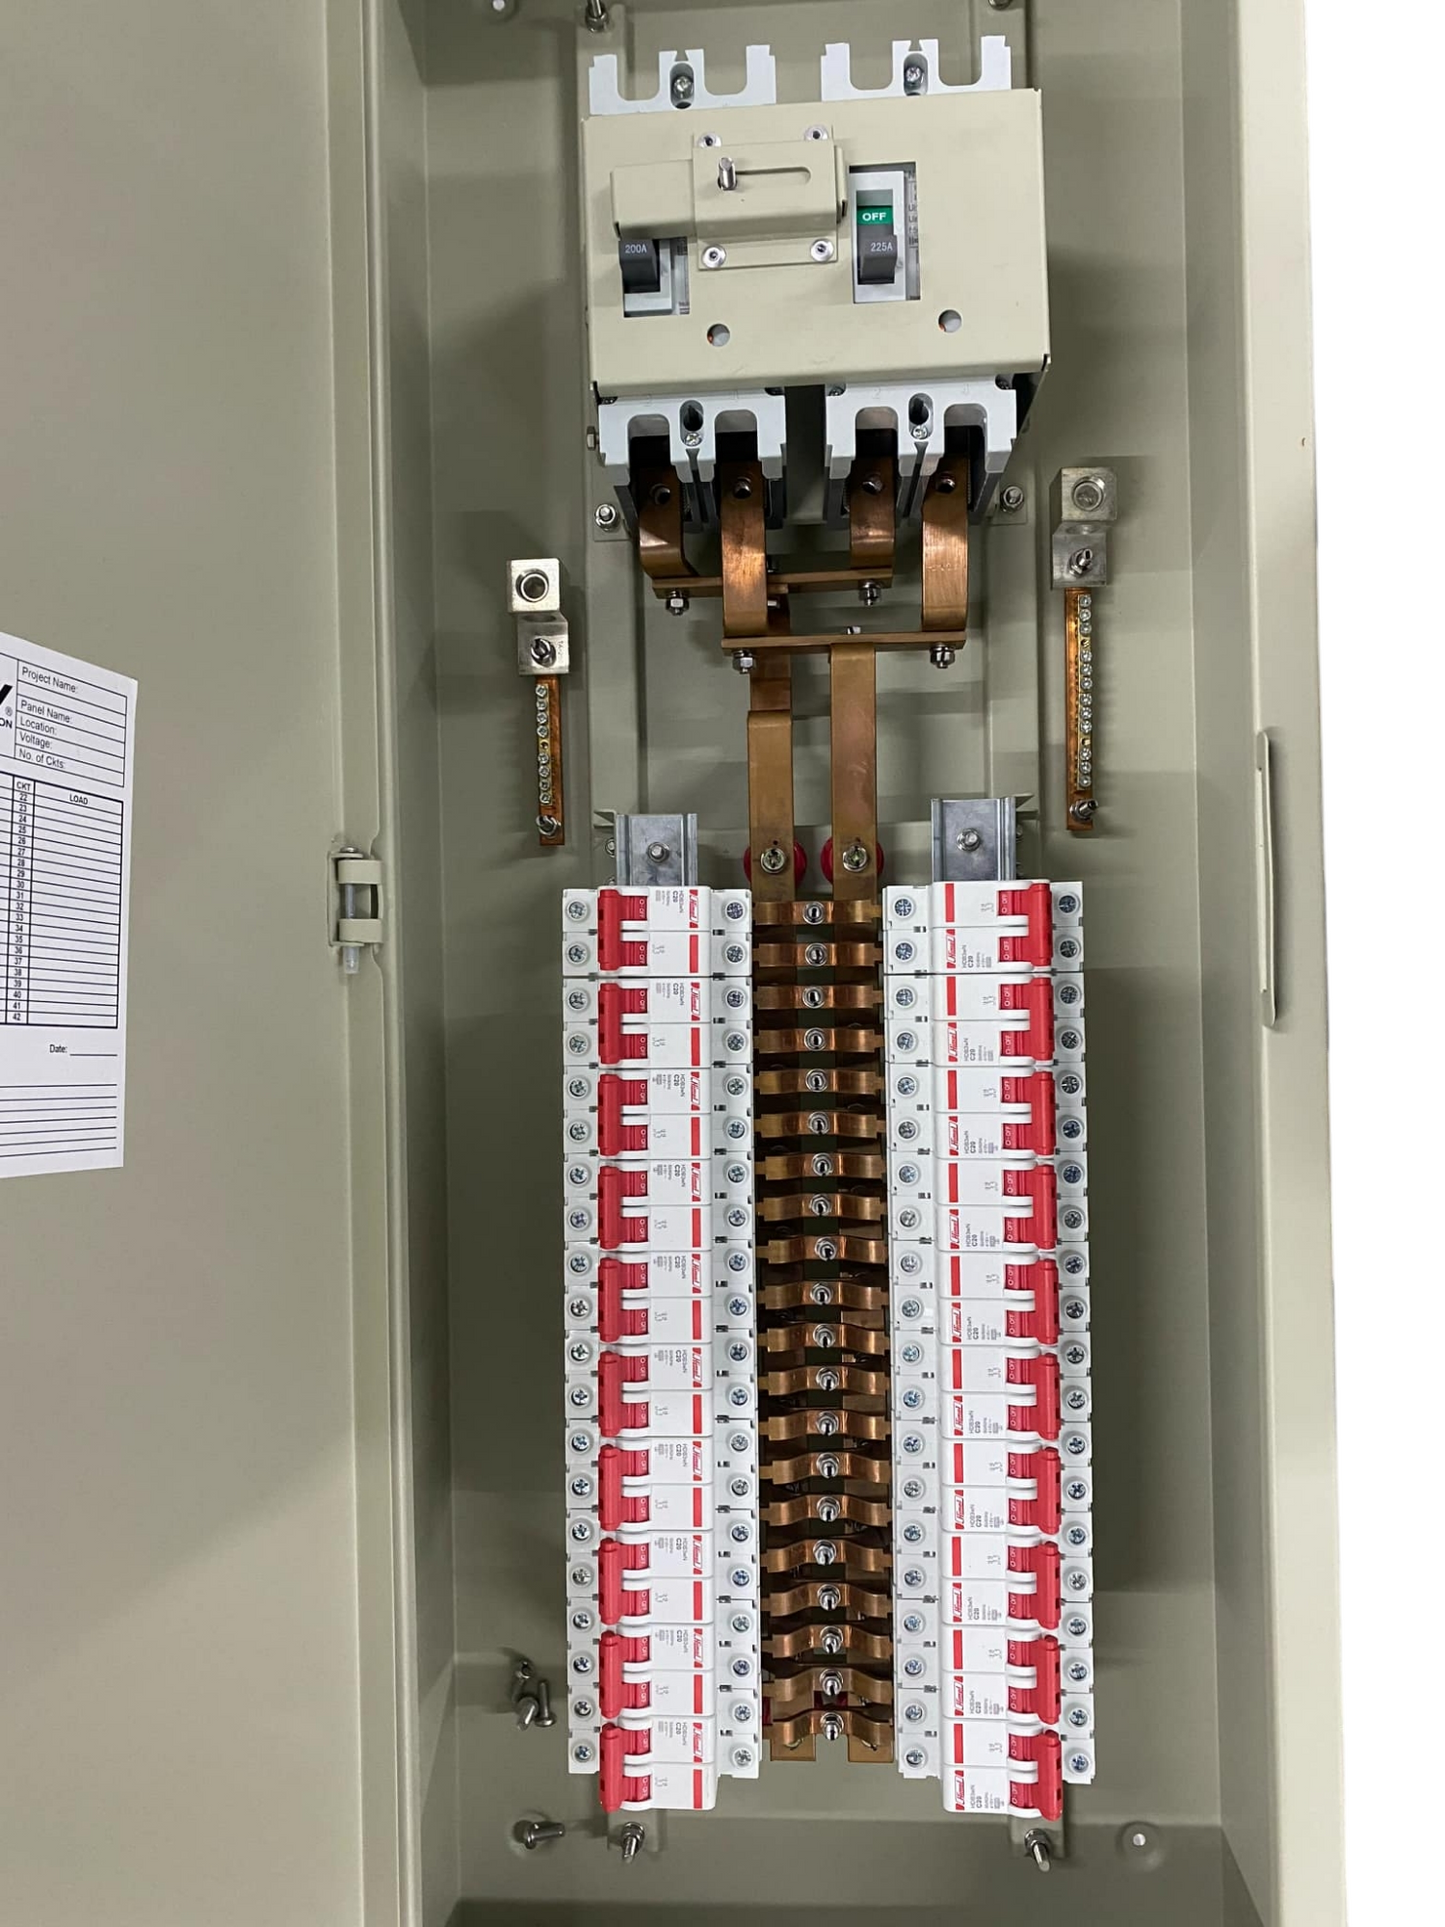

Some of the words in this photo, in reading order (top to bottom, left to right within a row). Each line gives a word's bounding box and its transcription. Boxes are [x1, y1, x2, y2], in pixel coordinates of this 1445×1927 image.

[862, 212, 887, 222] OFF
[625, 244, 647, 254] 200A
[870, 242, 893, 252] 225A
[21, 666, 51, 685] Project
[53, 677, 79, 693] Name:
[21, 700, 45, 716] Panel
[47, 708, 73, 724] Name:
[20, 716, 57, 735] Location:
[20, 731, 53, 750] Voltage:
[19, 749, 34, 761] No.
[36, 754, 44, 764] of
[16, 781, 31, 792] CKT
[20, 793, 28, 802] 22
[69, 794, 89, 805] LOAD
[19, 814, 27, 823] 24
[18, 847, 25, 856] 27
[16, 880, 25, 889] 30
[16, 891, 24, 899] 31
[16, 902, 24, 911] 32
[15, 924, 24, 933] 34
[14, 957, 22, 966] 37
[13, 990, 22, 999] 40
[13, 1001, 21, 1010] 41
[12, 1012, 21, 1021] 42
[49, 1044, 68, 1054] Date:
